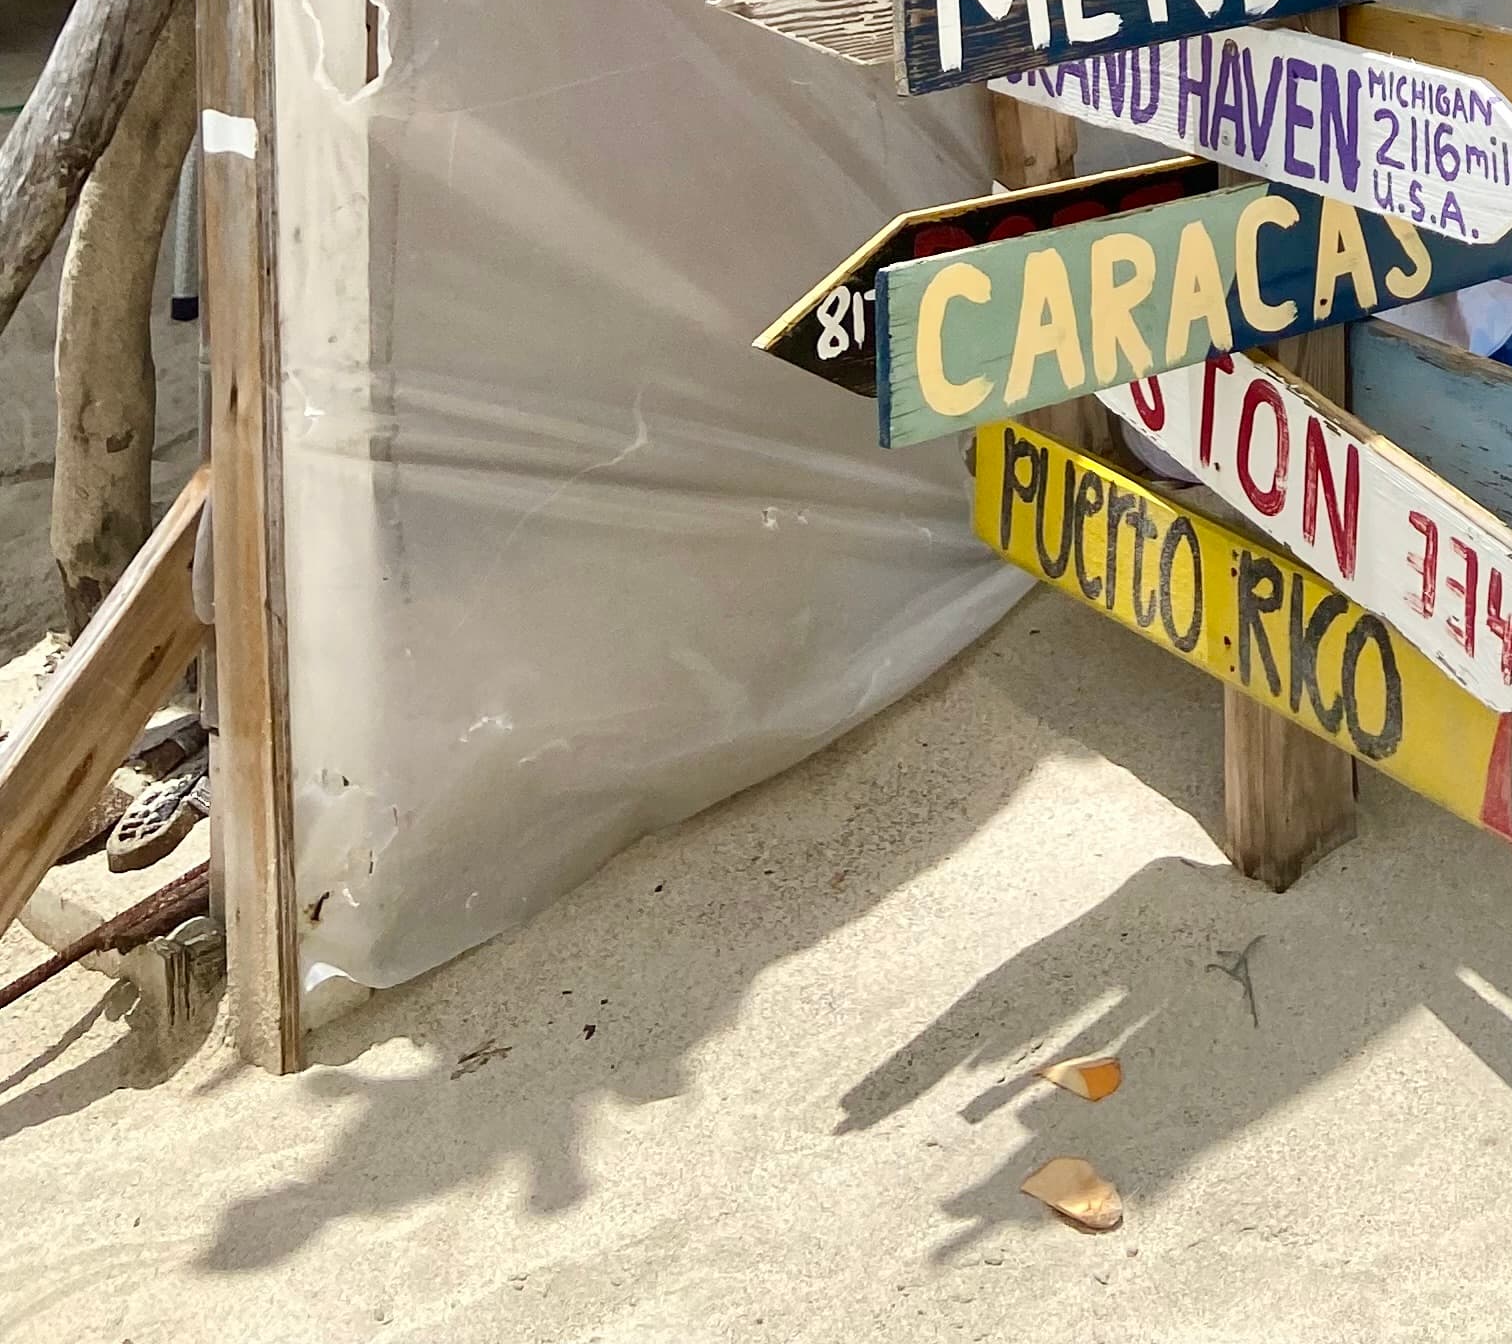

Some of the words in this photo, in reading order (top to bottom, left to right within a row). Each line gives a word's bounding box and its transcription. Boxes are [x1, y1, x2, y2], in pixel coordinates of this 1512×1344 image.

[1178, 34, 1361, 192] HAVEN
[1368, 67, 1492, 126] MICHIGAN
[1374, 108, 1461, 181] 2116
[816, 285, 876, 361] 81
[917, 195, 1432, 417] CARACAS
[1239, 550, 1403, 761] RICO
